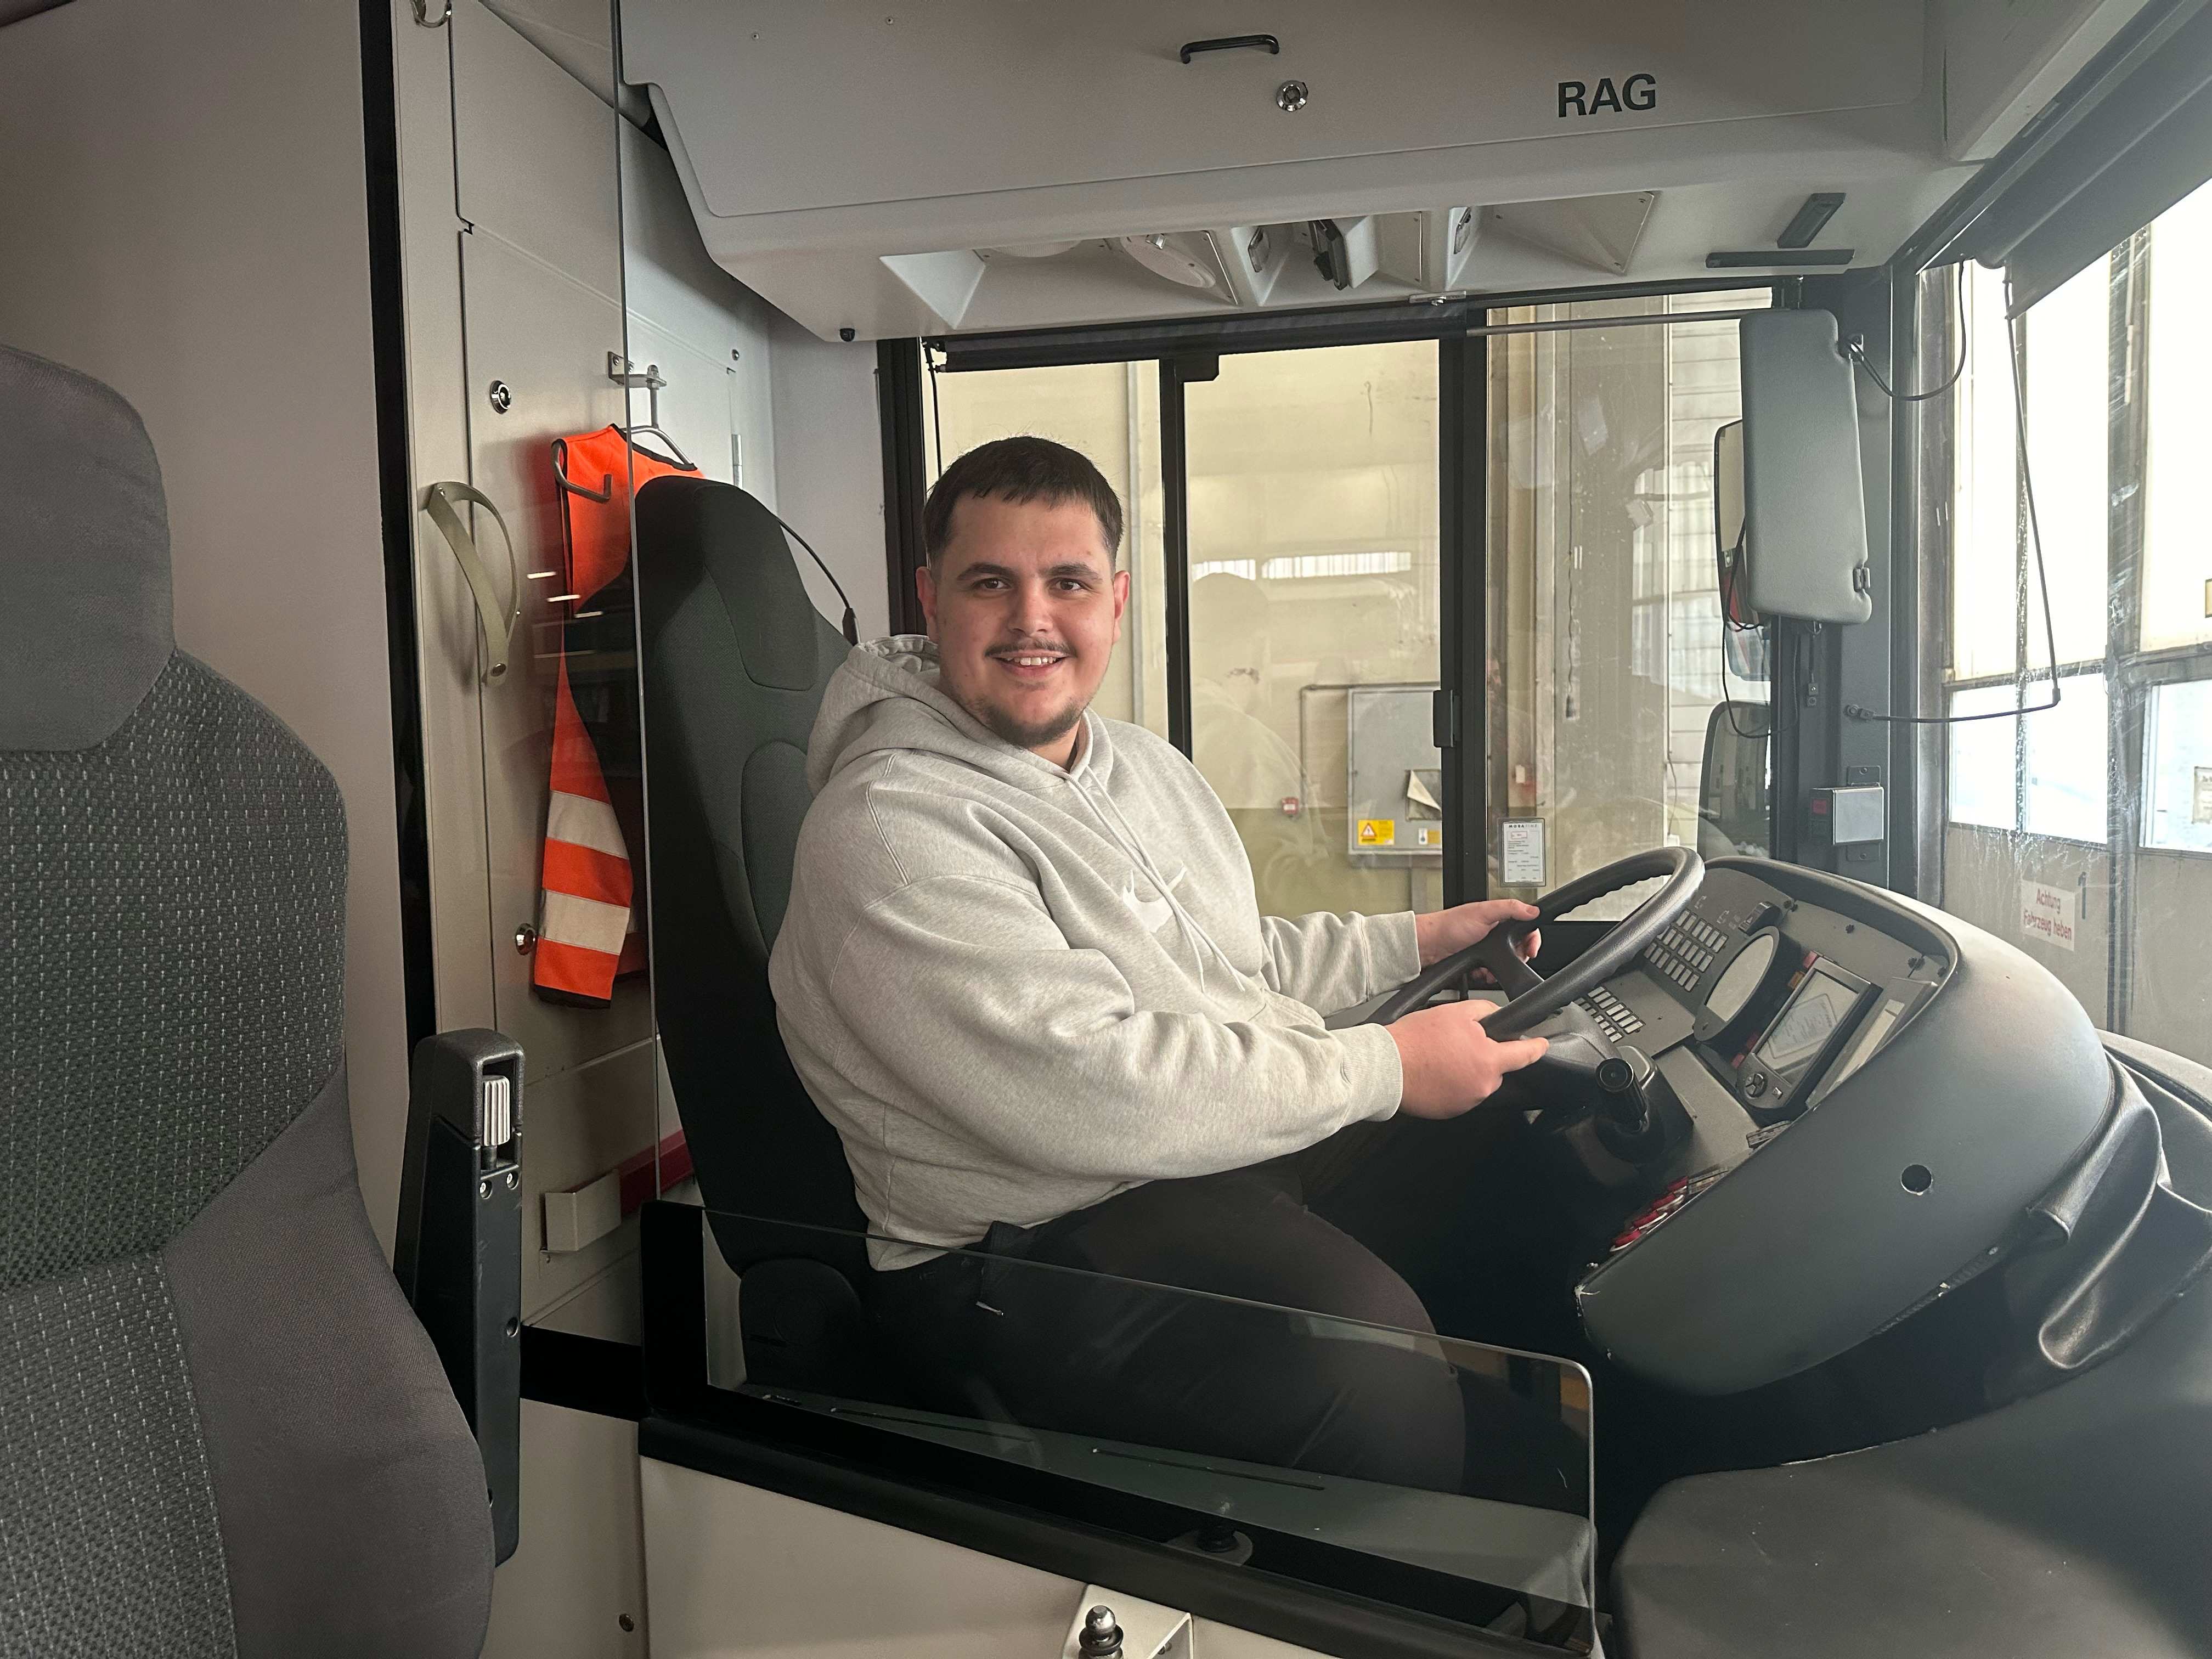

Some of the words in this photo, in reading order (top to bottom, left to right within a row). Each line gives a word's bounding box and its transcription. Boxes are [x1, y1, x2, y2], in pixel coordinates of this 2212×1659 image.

[1558, 73, 1656, 117] RAG
[2036, 888, 2060, 914] Achtung
[2024, 909, 2051, 936] Fahrzeug
[2053, 917, 2072, 940] heben
